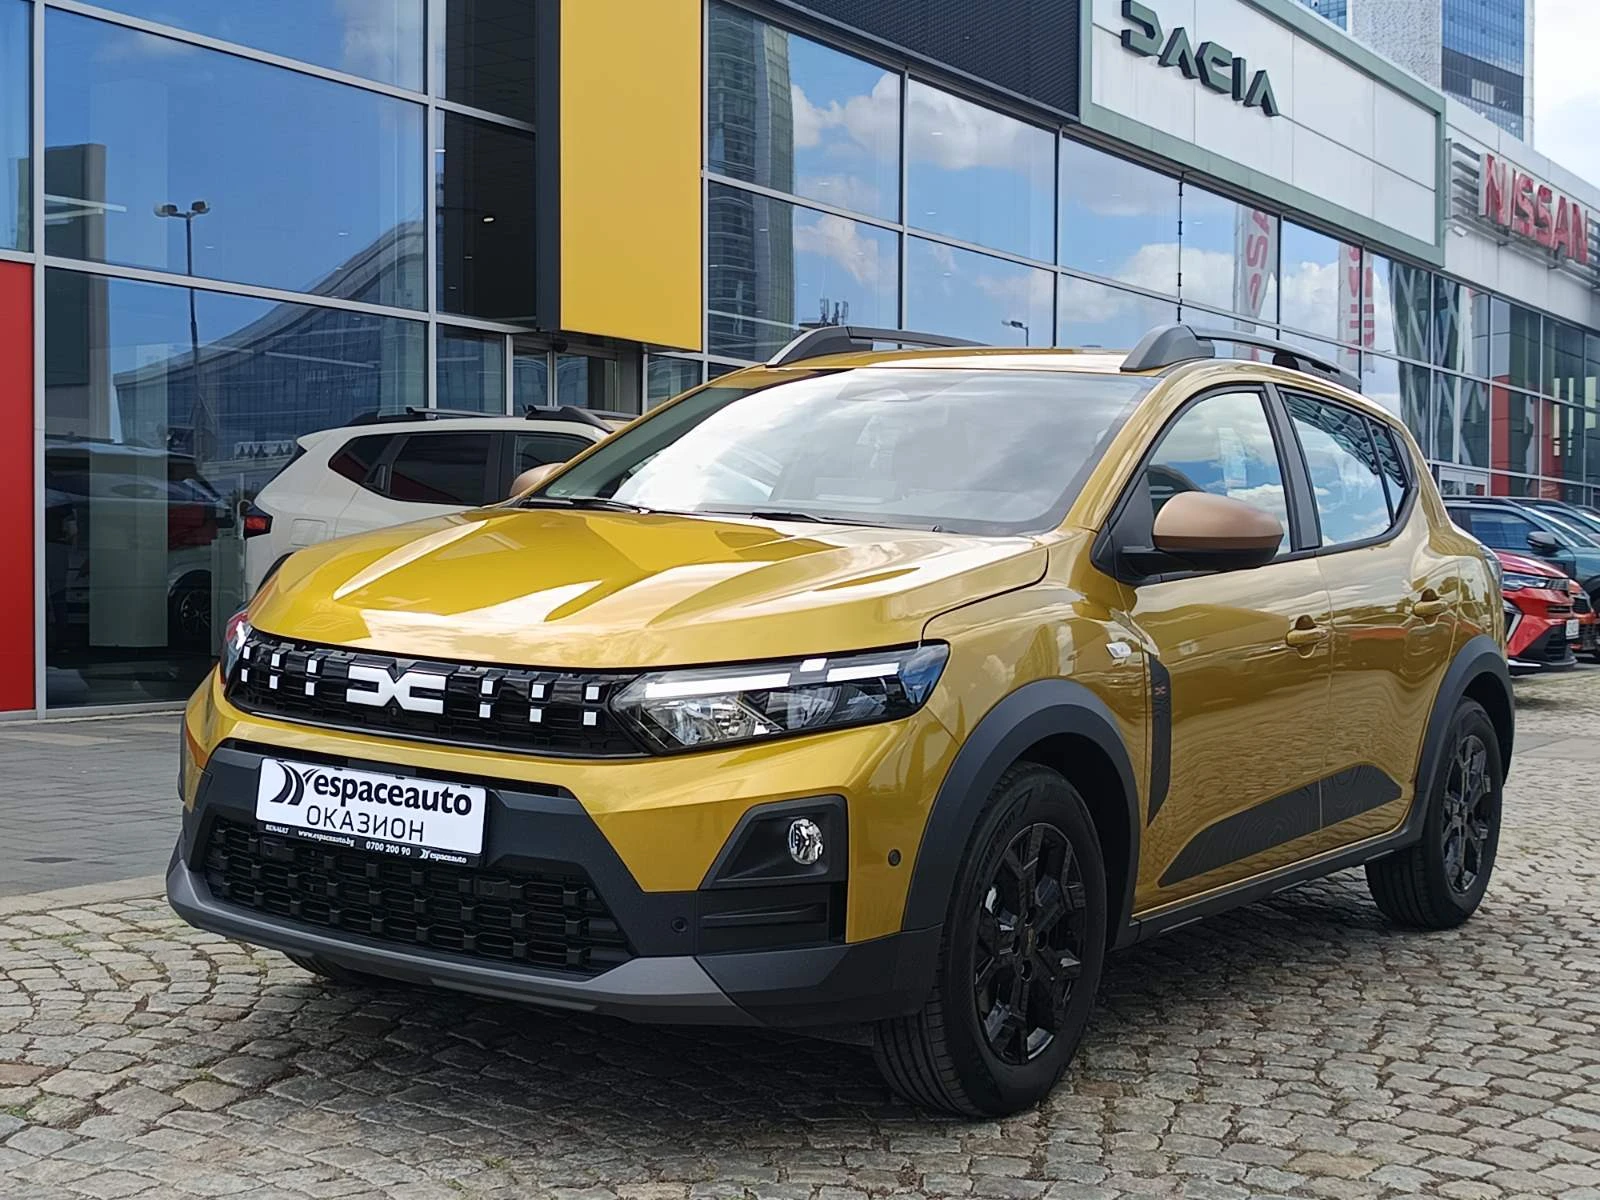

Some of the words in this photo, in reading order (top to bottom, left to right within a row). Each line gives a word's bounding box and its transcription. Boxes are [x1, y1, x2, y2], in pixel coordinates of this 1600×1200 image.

[1121, 0, 1279, 117] DACIA
[1479, 153, 1588, 265] NISSAN
[313, 773, 472, 816] espaceauto
[306, 805, 425, 842] ОКАЗИОН
[366, 841, 384, 851] 0700
[385, 844, 400, 854] 200
[401, 847, 411, 856] 90
